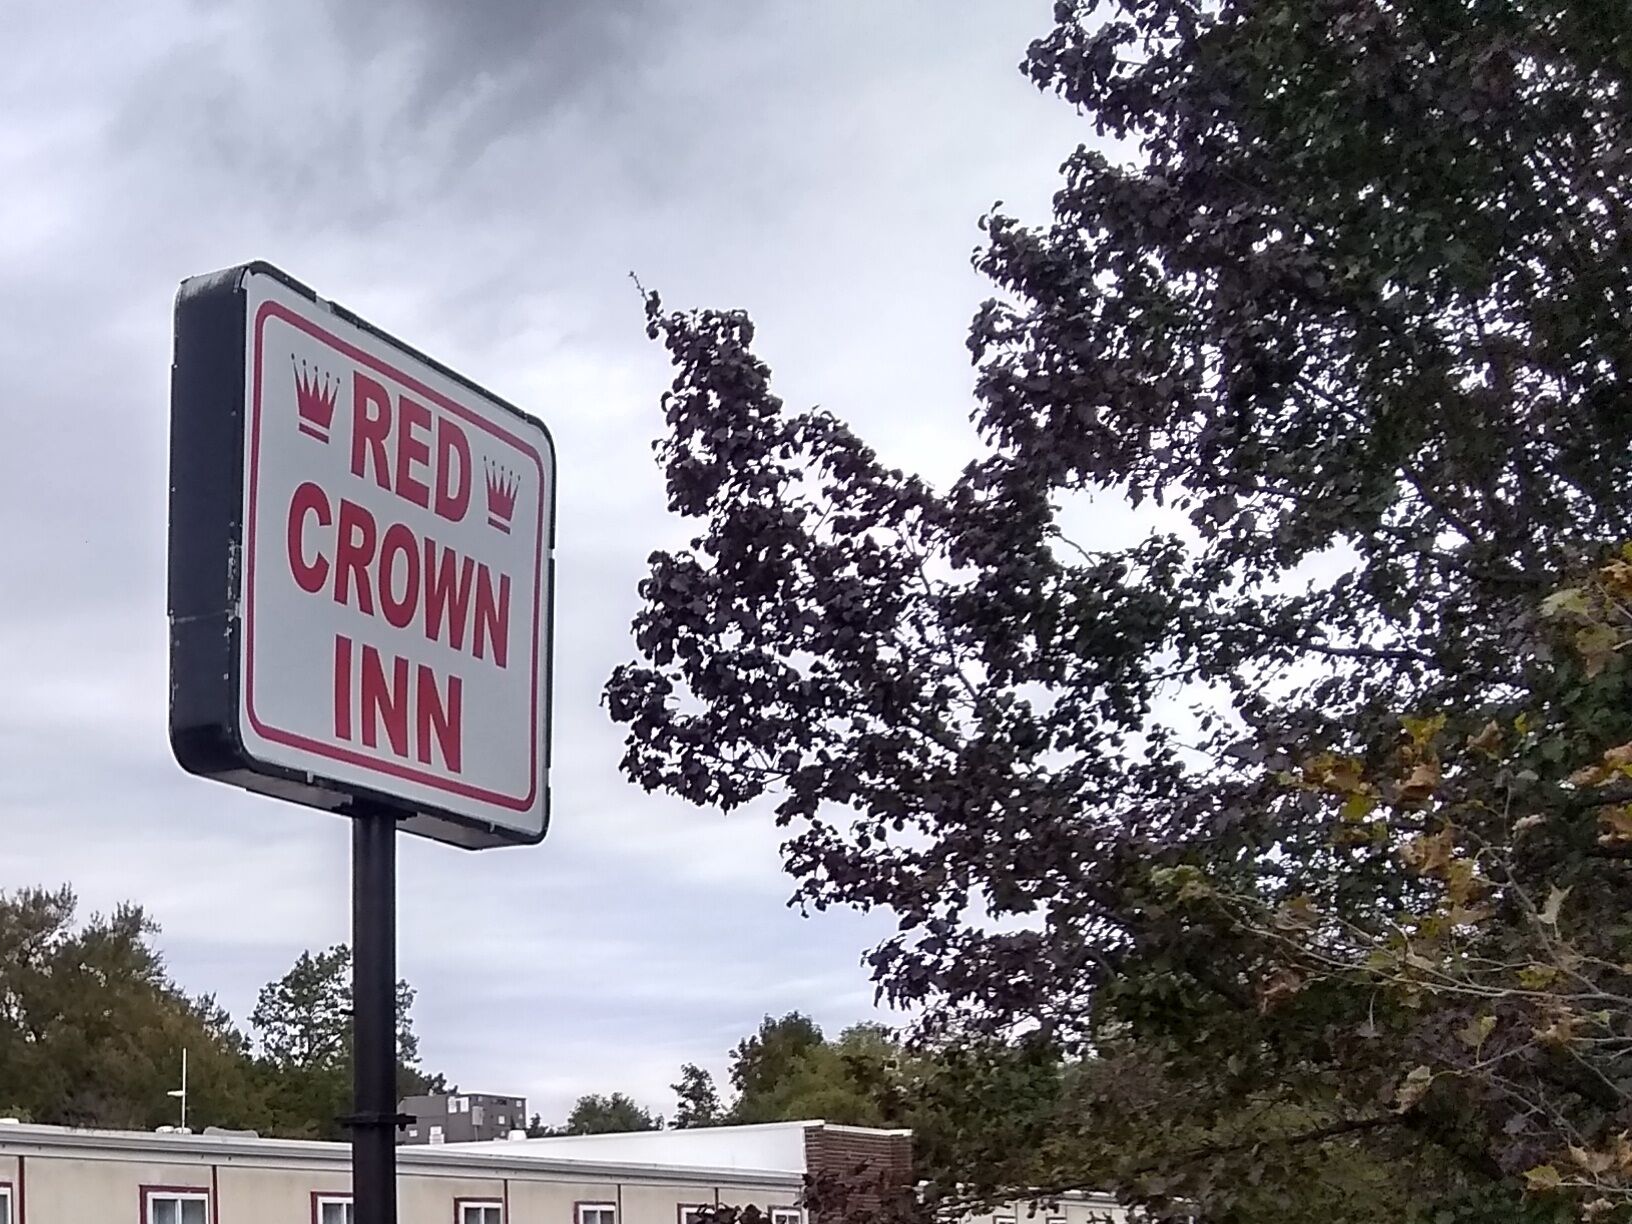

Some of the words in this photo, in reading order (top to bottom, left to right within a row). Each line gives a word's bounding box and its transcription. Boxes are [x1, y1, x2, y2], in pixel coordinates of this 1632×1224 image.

[350, 370, 470, 522] RED
[287, 482, 510, 669] CROWN
[335, 634, 462, 773] INN
